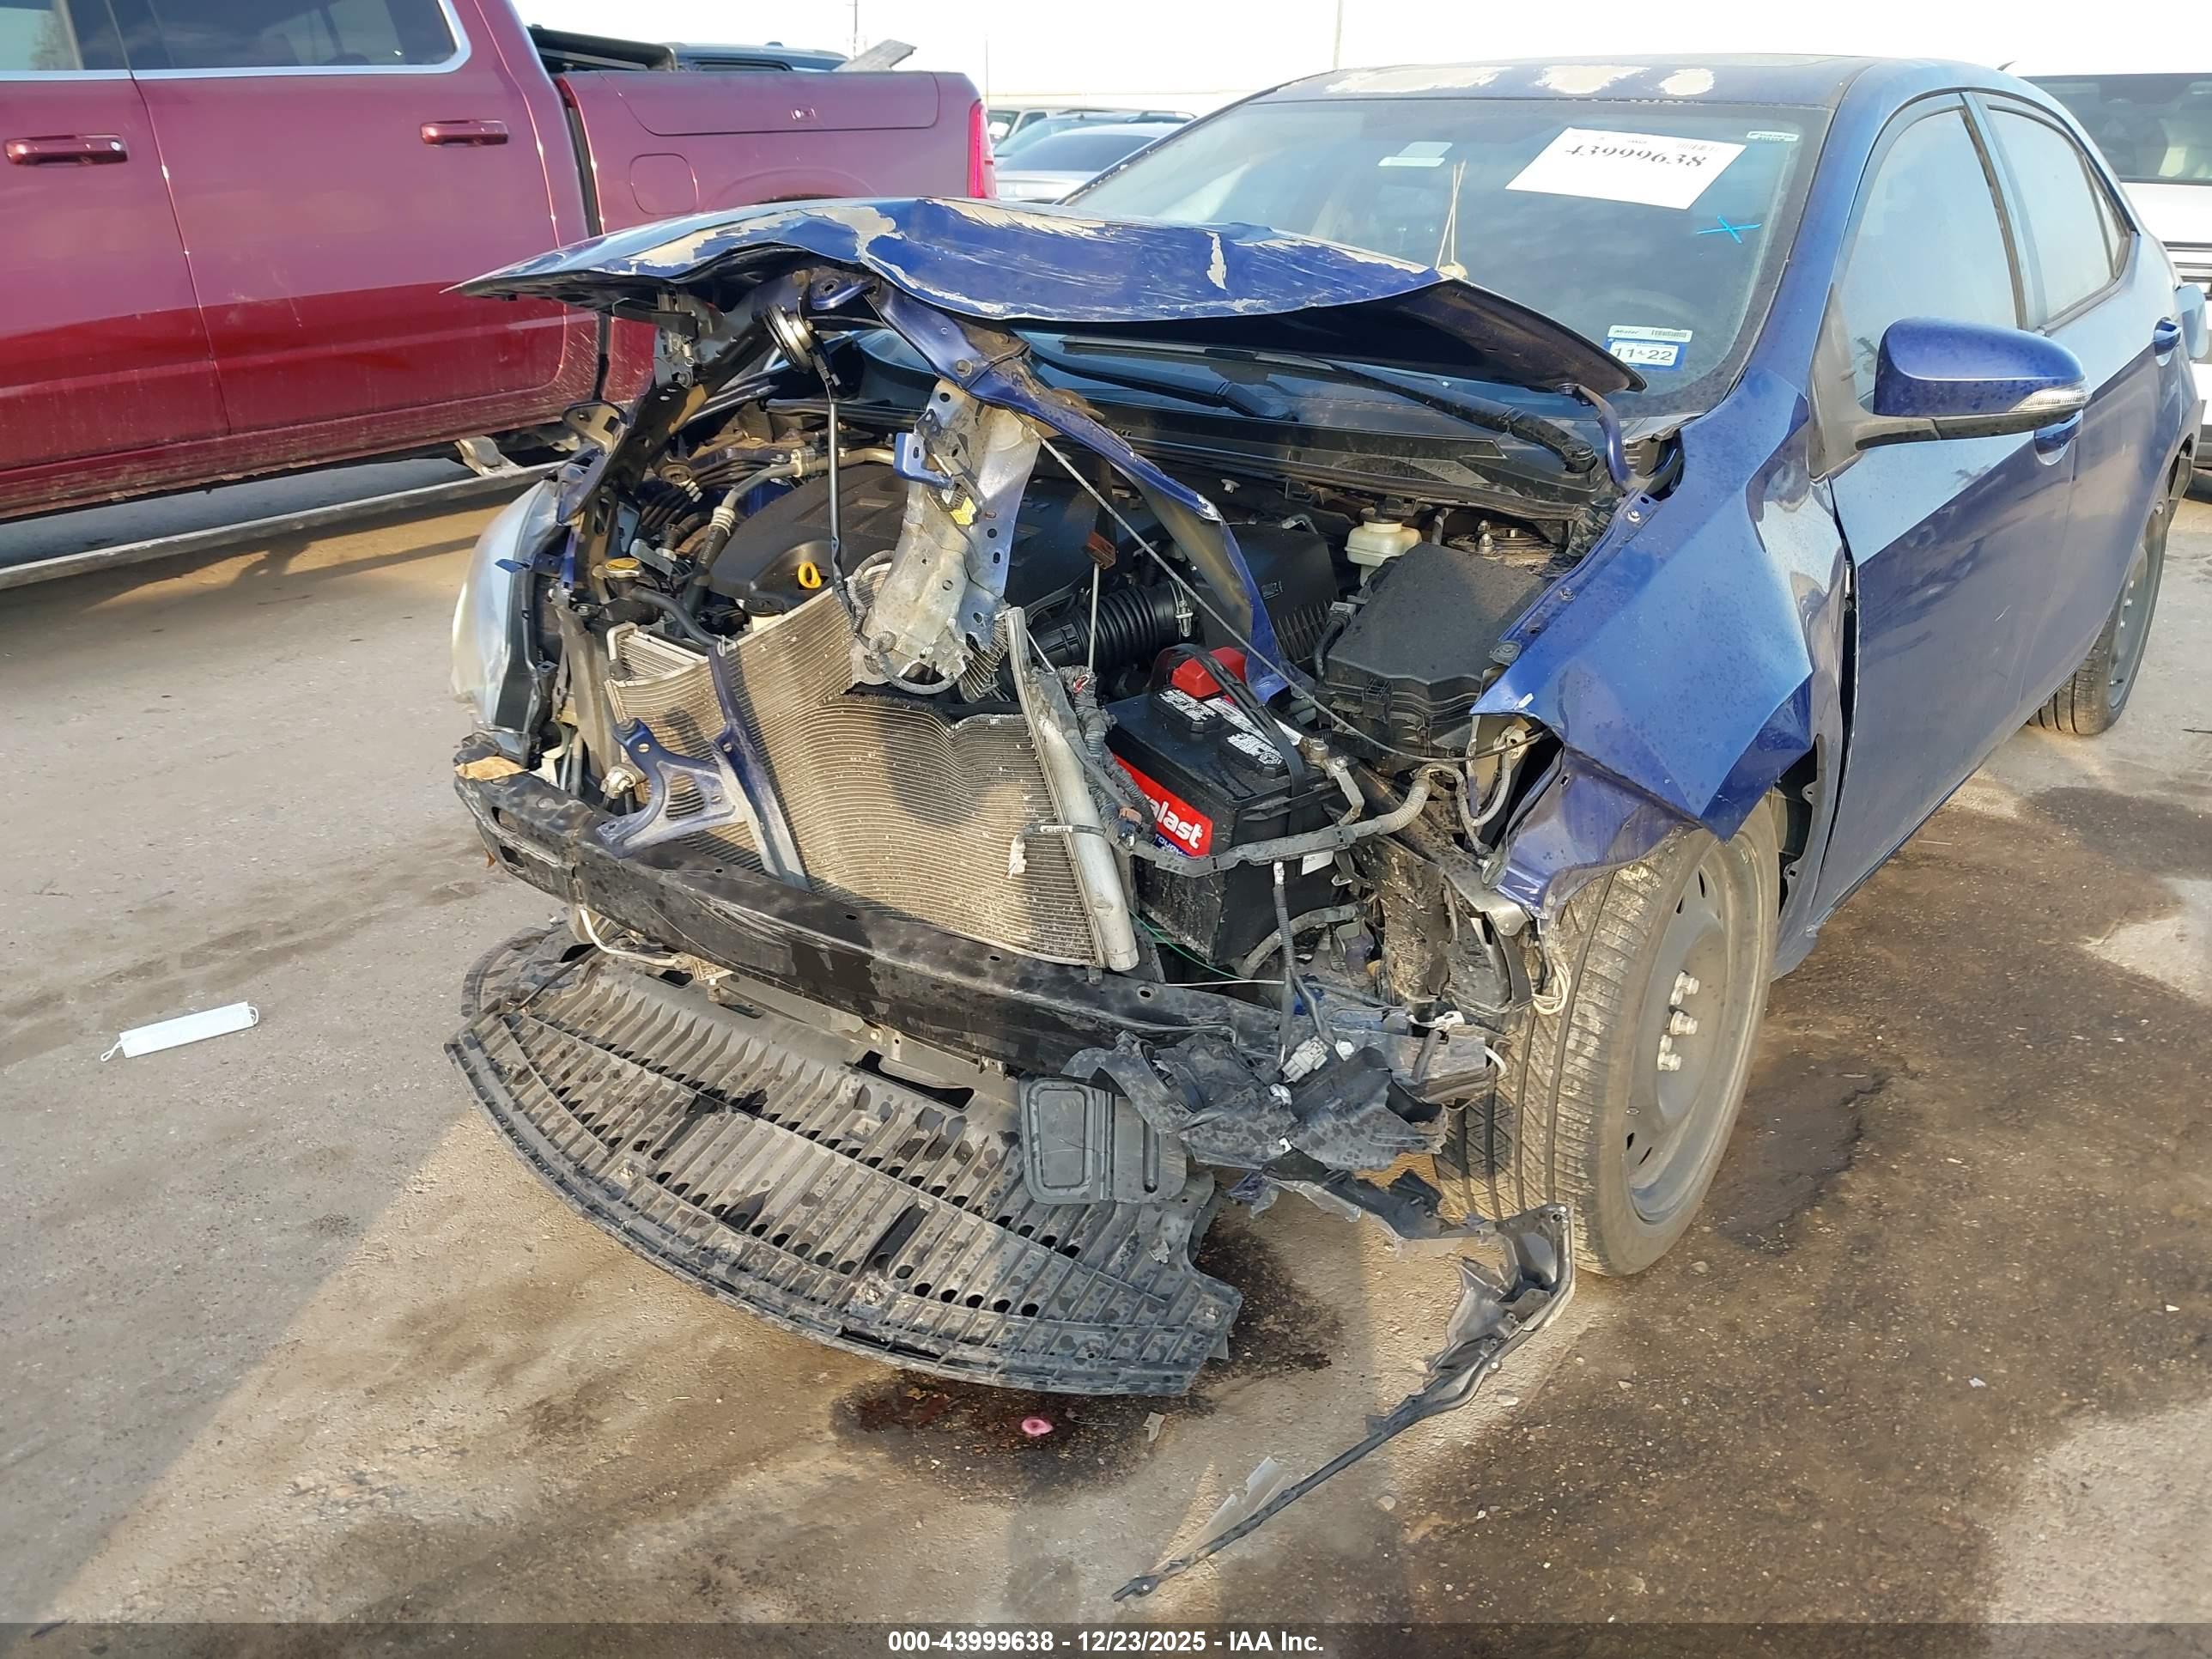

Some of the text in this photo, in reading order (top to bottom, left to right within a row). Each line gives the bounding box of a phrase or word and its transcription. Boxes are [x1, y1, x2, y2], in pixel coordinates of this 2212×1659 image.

[1565, 143, 1707, 167] 43999638
[1646, 349, 1673, 362] 22
[1144, 793, 1204, 850] alast
